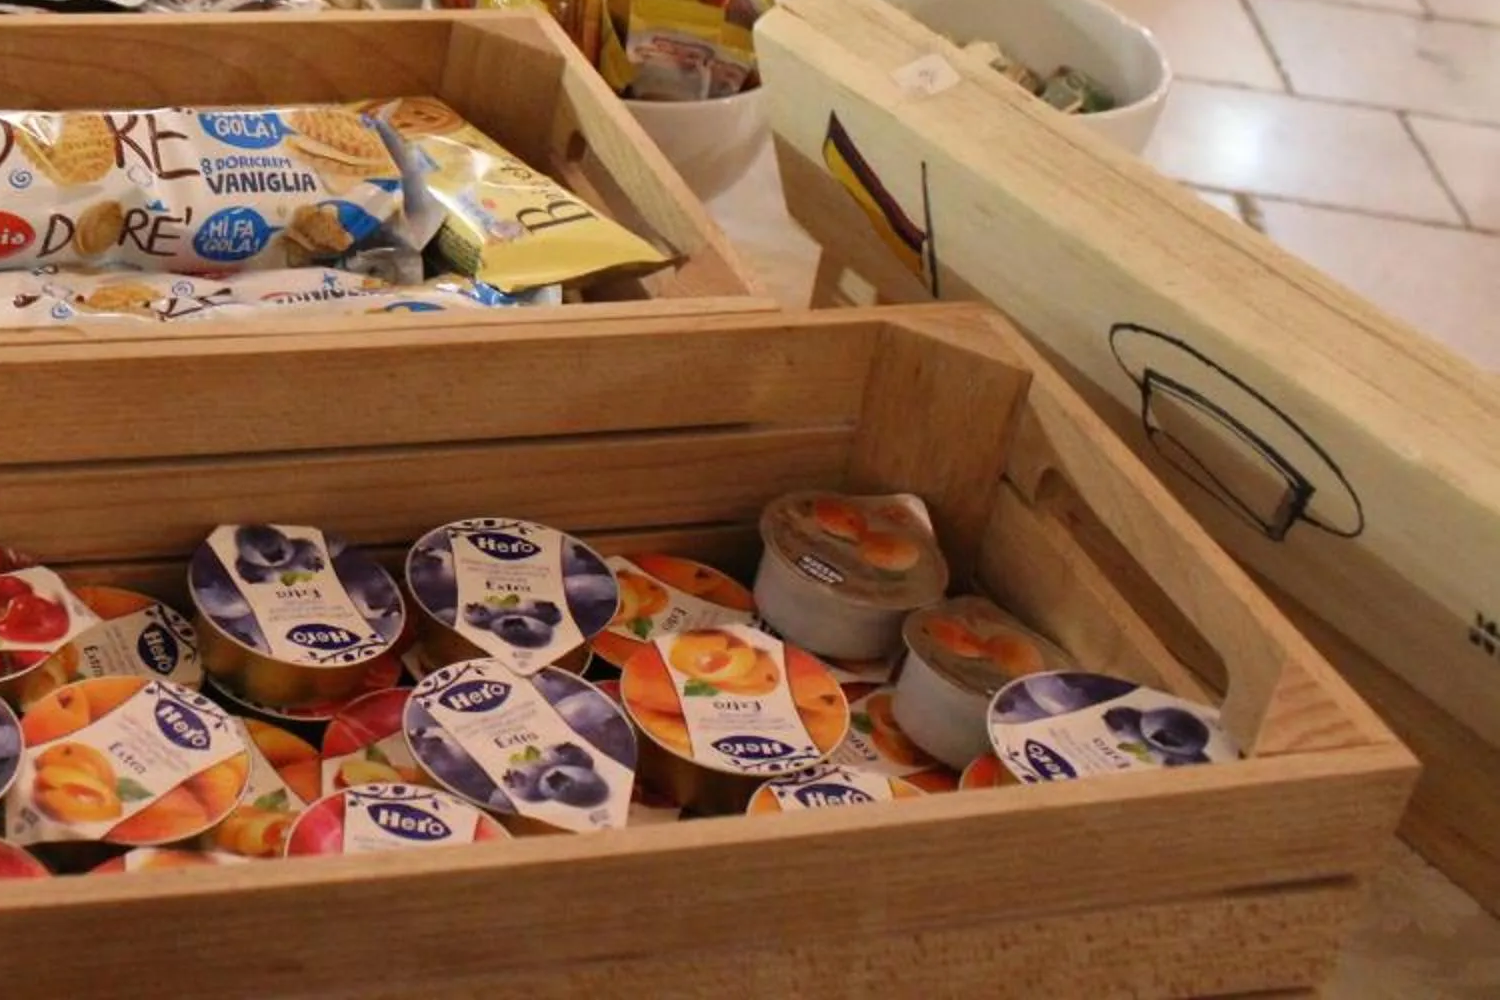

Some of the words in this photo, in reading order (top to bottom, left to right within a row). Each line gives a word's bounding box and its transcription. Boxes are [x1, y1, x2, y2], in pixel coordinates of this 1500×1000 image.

[215, 117, 279, 140] GOLA!
[206, 171, 317, 195] VANIGLIA
[477, 536, 536, 553] Hero
[291, 630, 352, 646] Hero
[143, 630, 174, 672] Hero
[447, 682, 507, 710] Hero
[157, 705, 207, 748] Hero
[717, 741, 784, 758] Hero
[378, 808, 446, 836] Hero
